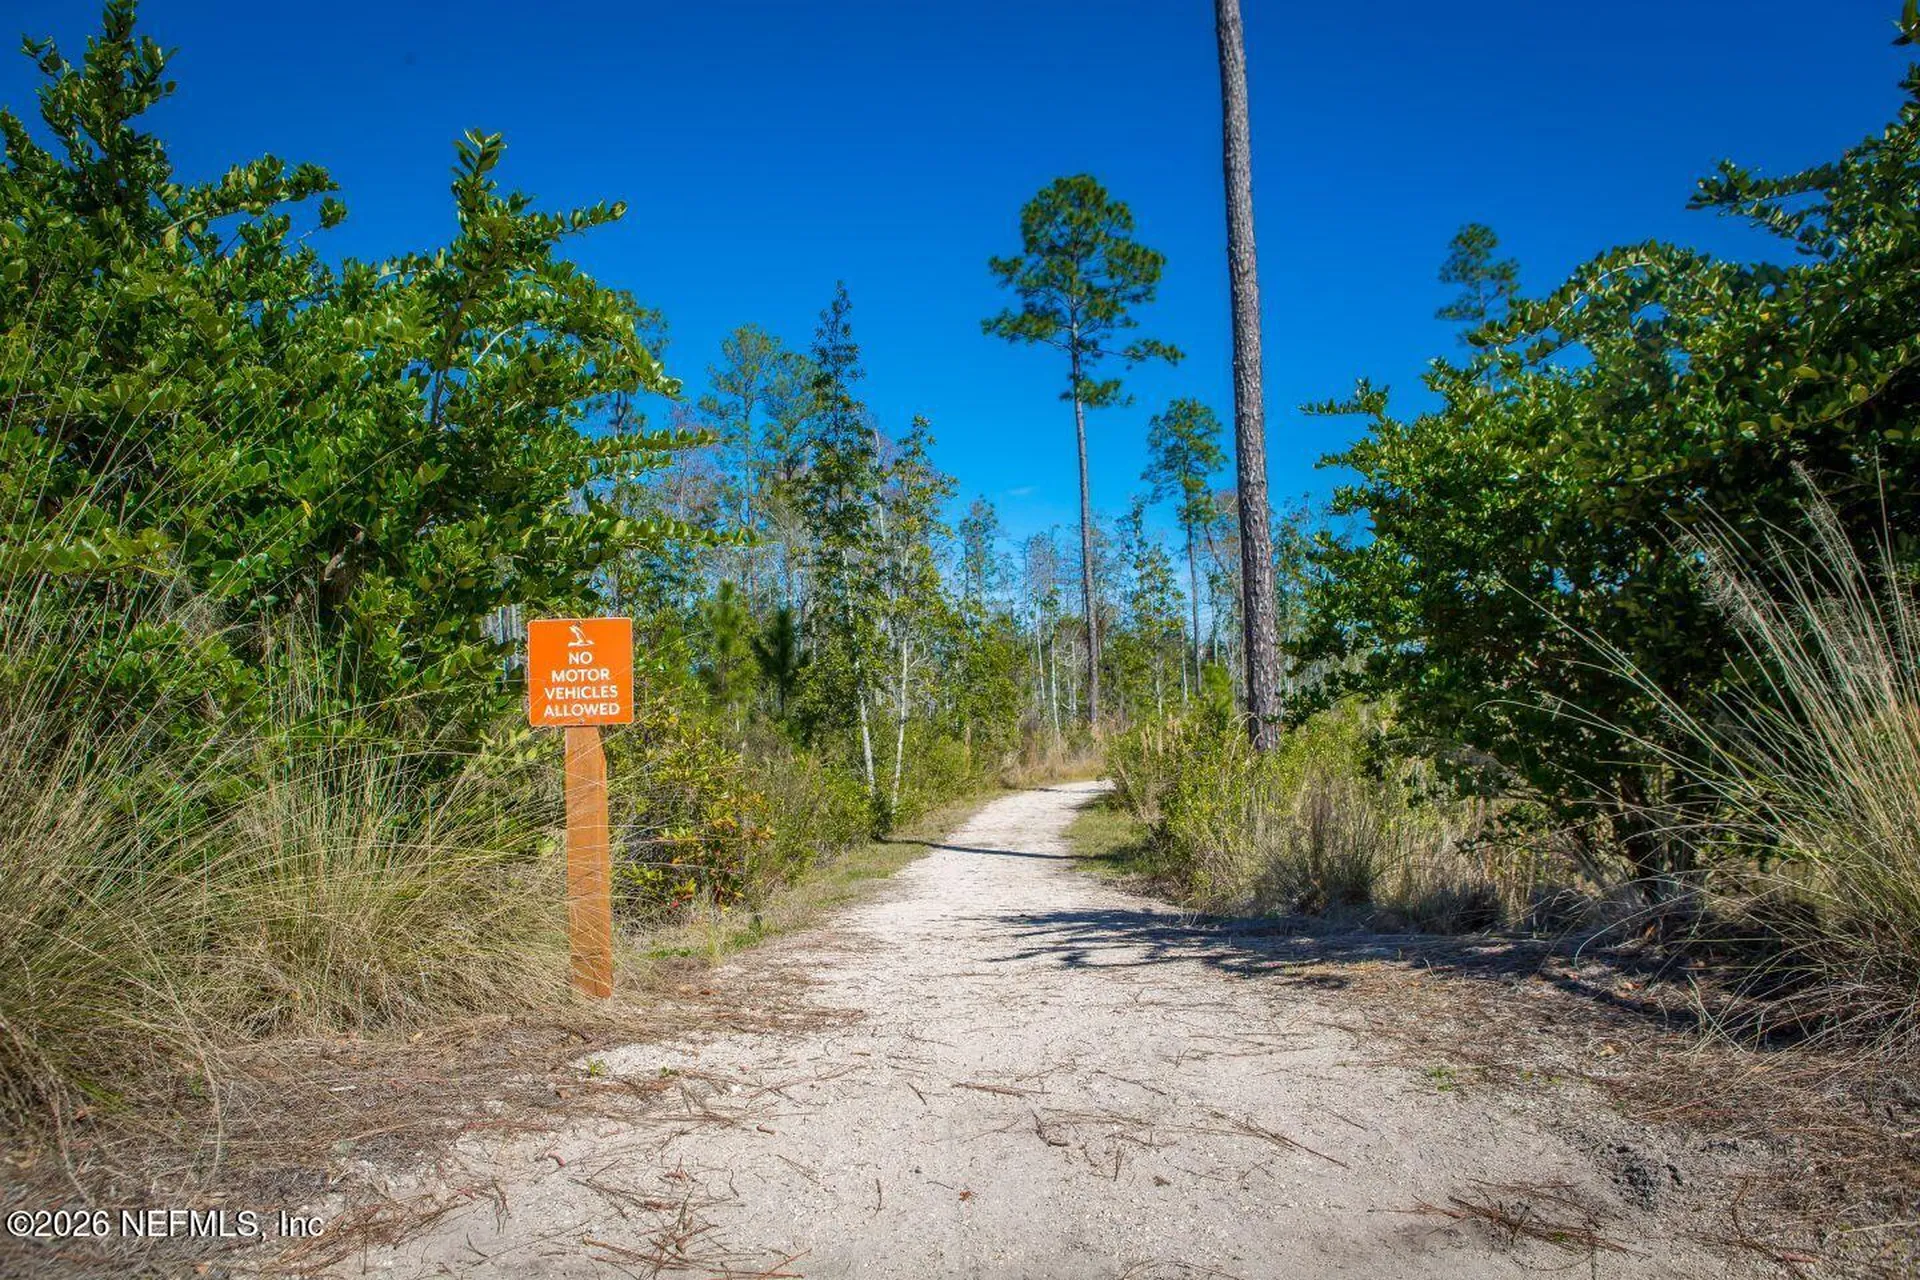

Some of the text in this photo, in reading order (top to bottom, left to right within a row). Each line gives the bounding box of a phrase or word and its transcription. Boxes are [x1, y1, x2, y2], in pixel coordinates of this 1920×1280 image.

[569, 651, 593, 665] NO
[551, 668, 610, 683] MOTOR
[544, 685, 618, 700] VEHICLES
[544, 702, 620, 717] ALLOWED
